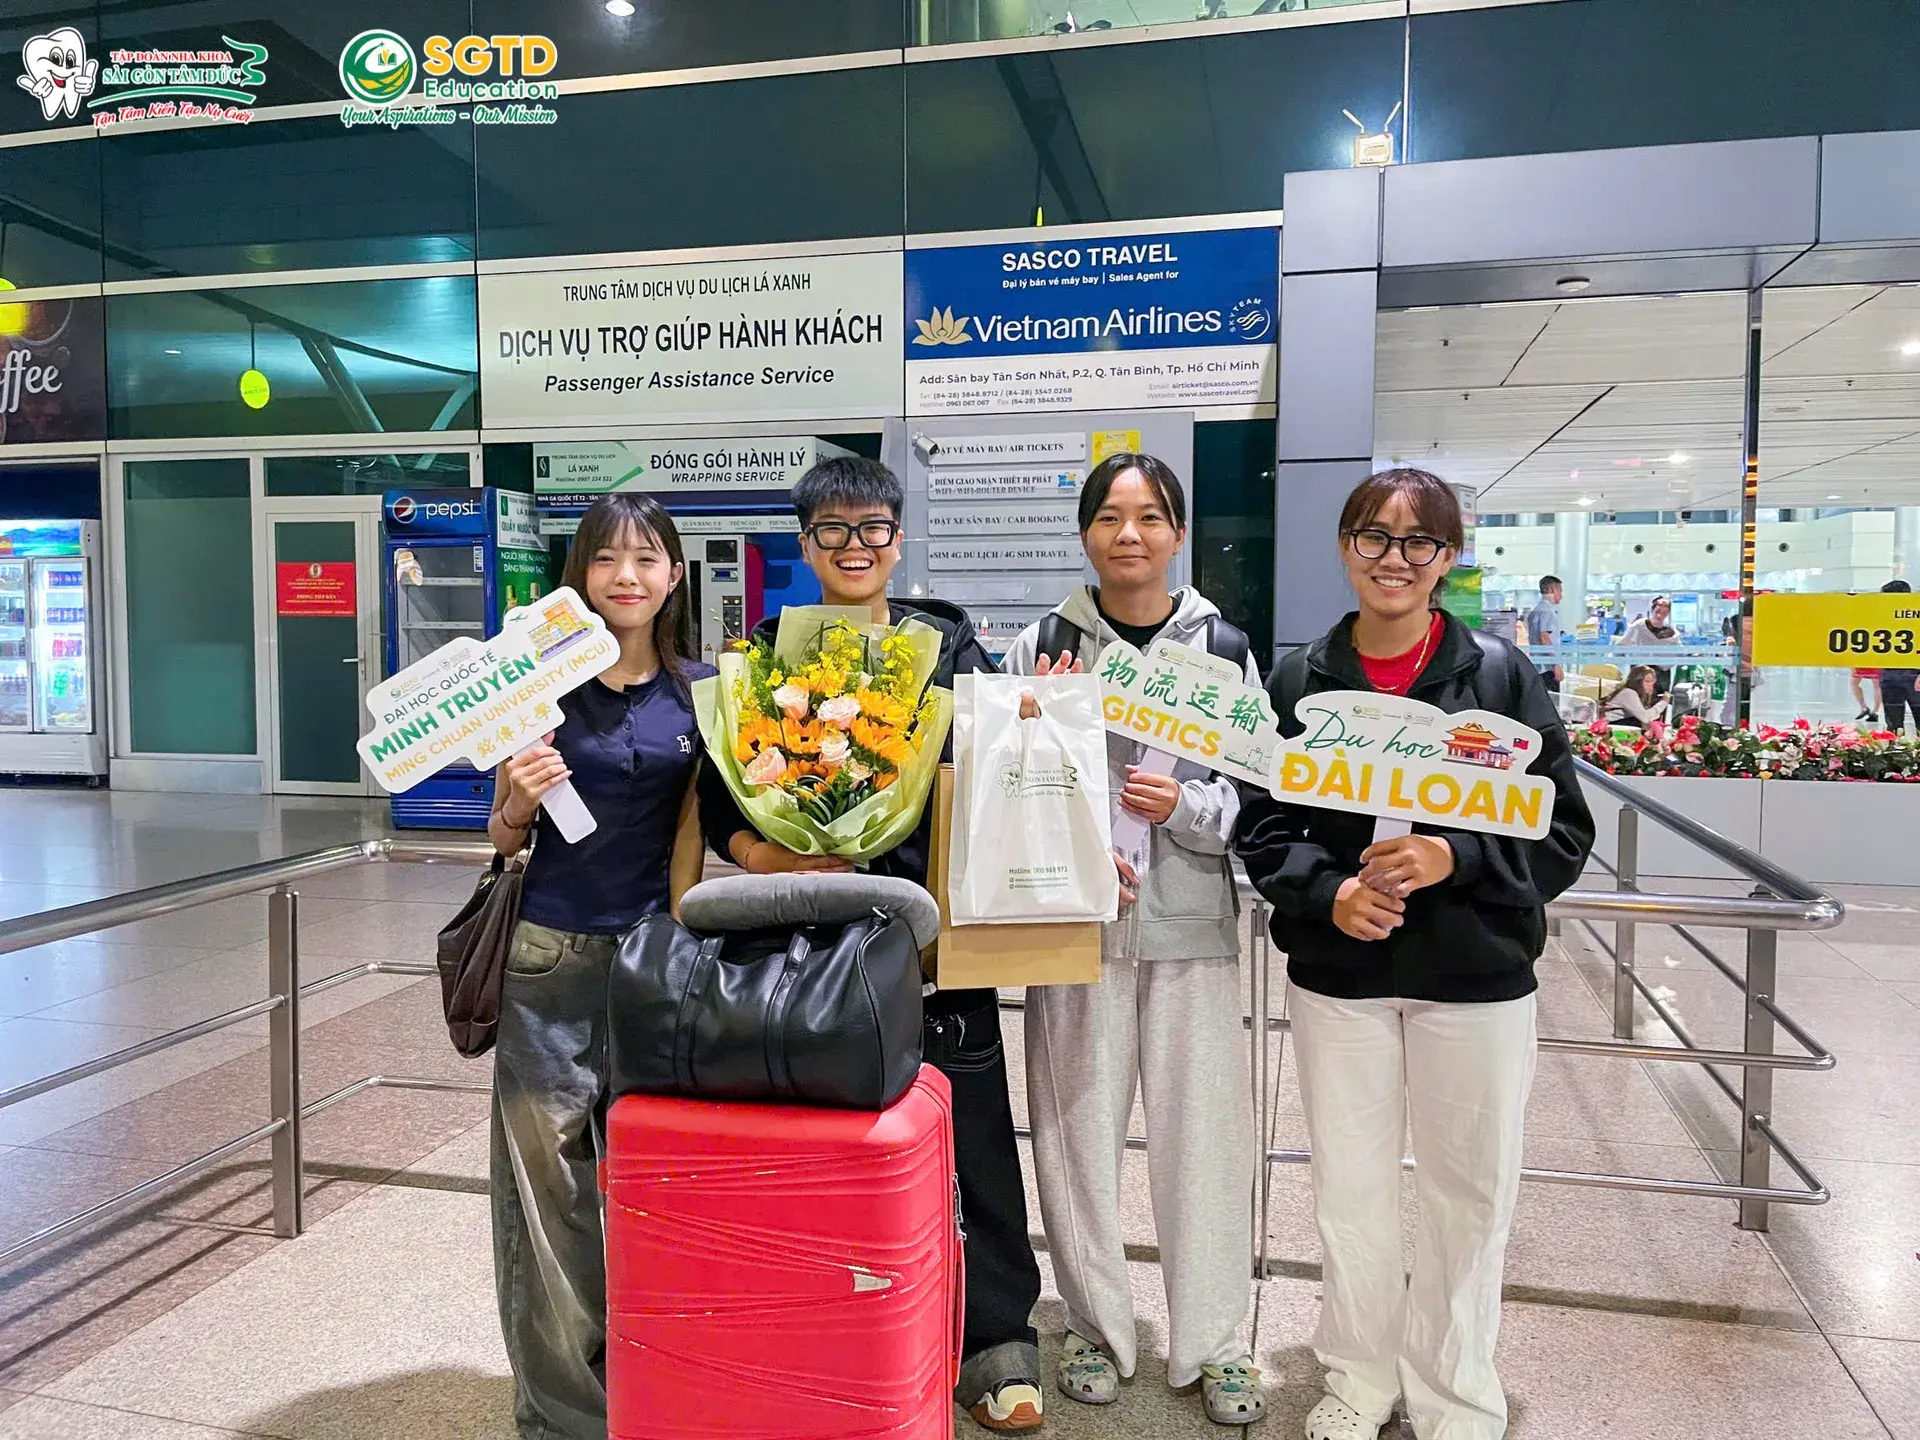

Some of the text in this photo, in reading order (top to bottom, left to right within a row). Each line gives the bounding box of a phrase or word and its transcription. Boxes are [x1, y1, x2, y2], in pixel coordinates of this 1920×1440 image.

[1002, 244, 1178, 272] SASCO TRAVEL
[563, 271, 811, 301] TRUNG TÂM DỊCH VỤ DU LỊCH LÁ XANH
[1002, 271, 1179, 289] Đại lý bán vé máy bay Sales Agent for
[499, 309, 883, 364] DỊCH VỤ TRỢ GIÚP HÀNH KHÁCH
[972, 306, 1222, 343] Vietnam Airlines
[0, 349, 62, 413] ffee
[544, 365, 835, 395] Passenger Assistance Service
[919, 375, 945, 385] Add:
[947, 374, 967, 384] Sân
[970, 373, 989, 385] bay
[992, 372, 1012, 382] Tân
[1015, 371, 1036, 381] Sơn
[1095, 368, 1107, 379] Q.
[1110, 366, 1131, 377] Tân
[1134, 365, 1164, 376] Bình,
[1167, 364, 1184, 376] Tp.
[1187, 362, 1204, 373] Hồ
[1207, 361, 1227, 372] Chí
[1230, 360, 1260, 371] Minh
[651, 450, 698, 469] ĐÓNG
[703, 449, 731, 468] GÓI
[738, 448, 784, 467] HÀNH
[790, 447, 805, 466] LÝ
[1009, 444, 1025, 452] AIR
[1027, 442, 1064, 451] TICKETS
[568, 464, 599, 473] LÁ XANH
[671, 471, 785, 483] WRAPPING SERVICE
[955, 477, 975, 485] GIAO
[977, 476, 998, 486] NHẬN
[1032, 475, 1052, 484] PHÁT
[1008, 486, 1036, 494] DEVICE
[425, 499, 474, 519] pepsi
[934, 517, 951, 526] ĐẶT
[966, 515, 983, 524] SÂN
[985, 516, 1001, 524] BAY
[1007, 515, 1026, 523] CAR
[1028, 515, 1069, 523] BOOKING
[934, 551, 949, 559] SIM
[951, 551, 962, 559] 4G
[963, 551, 976, 559] DU
[977, 551, 998, 561] LỊCH
[1004, 551, 1015, 559] 4G
[1035, 550, 1069, 558] TRAVEL
[1000, 622, 1028, 630] TOURS
[1895, 608, 1920, 619] LIÊN
[384, 701, 408, 725] ĐẠI
[408, 687, 439, 711] HỌC
[440, 662, 480, 690] QUỐC
[479, 649, 497, 668] TẾ
[1101, 649, 1269, 735] 物流运输
[369, 652, 536, 763] MINH TRUYỀN
[384, 640, 612, 783] MING CHUAN UNIVERSITY (MCU)
[477, 700, 552, 758] 銘傳大學
[1103, 696, 1222, 756] GISTICS
[1304, 707, 1443, 759] Du học
[1280, 748, 1543, 829] ĐÀI LOAN
